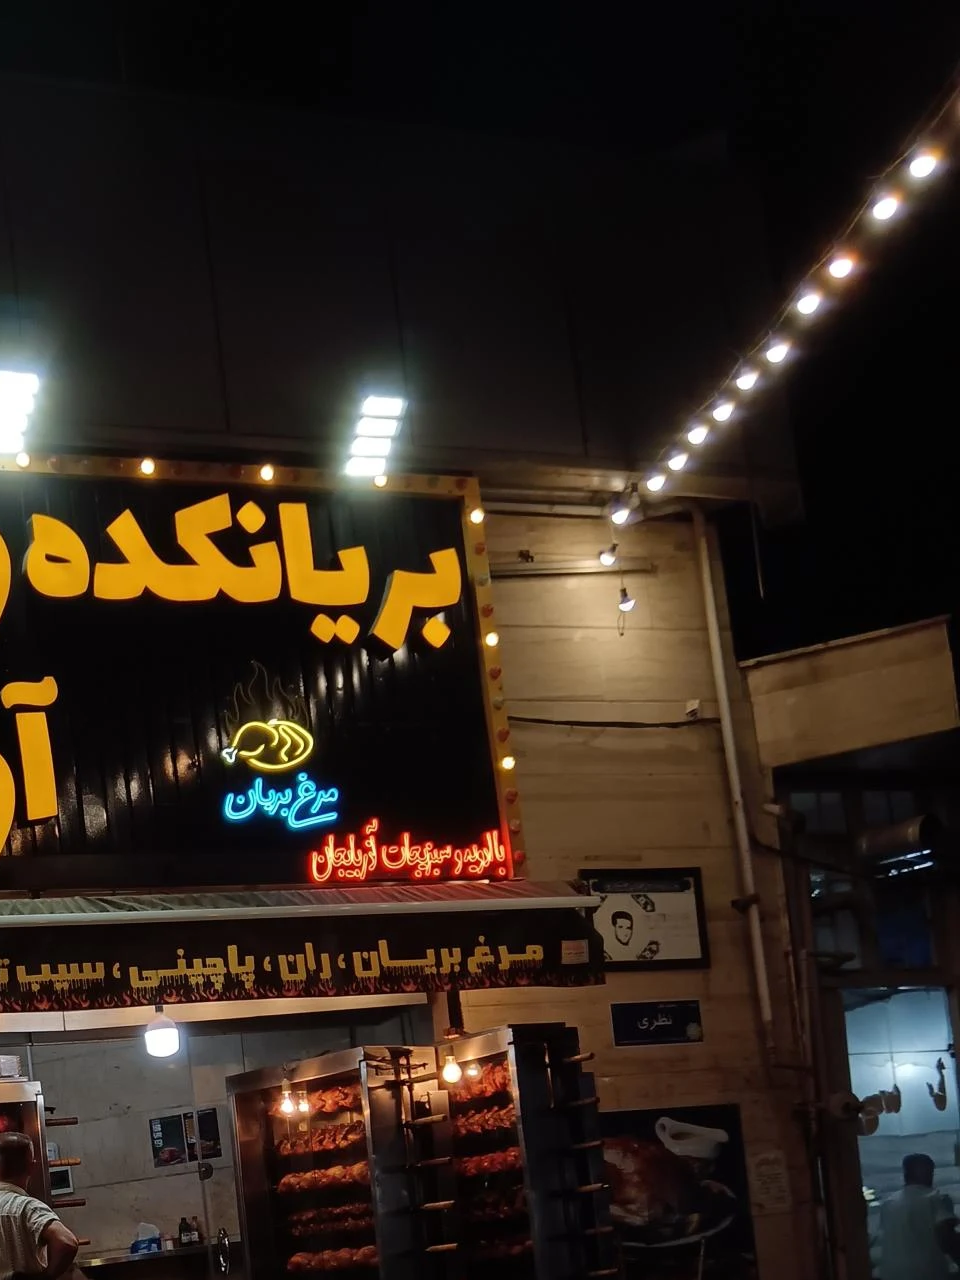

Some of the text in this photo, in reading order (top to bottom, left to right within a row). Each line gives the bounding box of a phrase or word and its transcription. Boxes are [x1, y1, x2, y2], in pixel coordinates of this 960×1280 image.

[23, 492, 463, 652] بریانکده
[224, 772, 339, 828] مرغ بریان
[16, 961, 105, 996] سیب
[468, 935, 544, 975] مرغ
